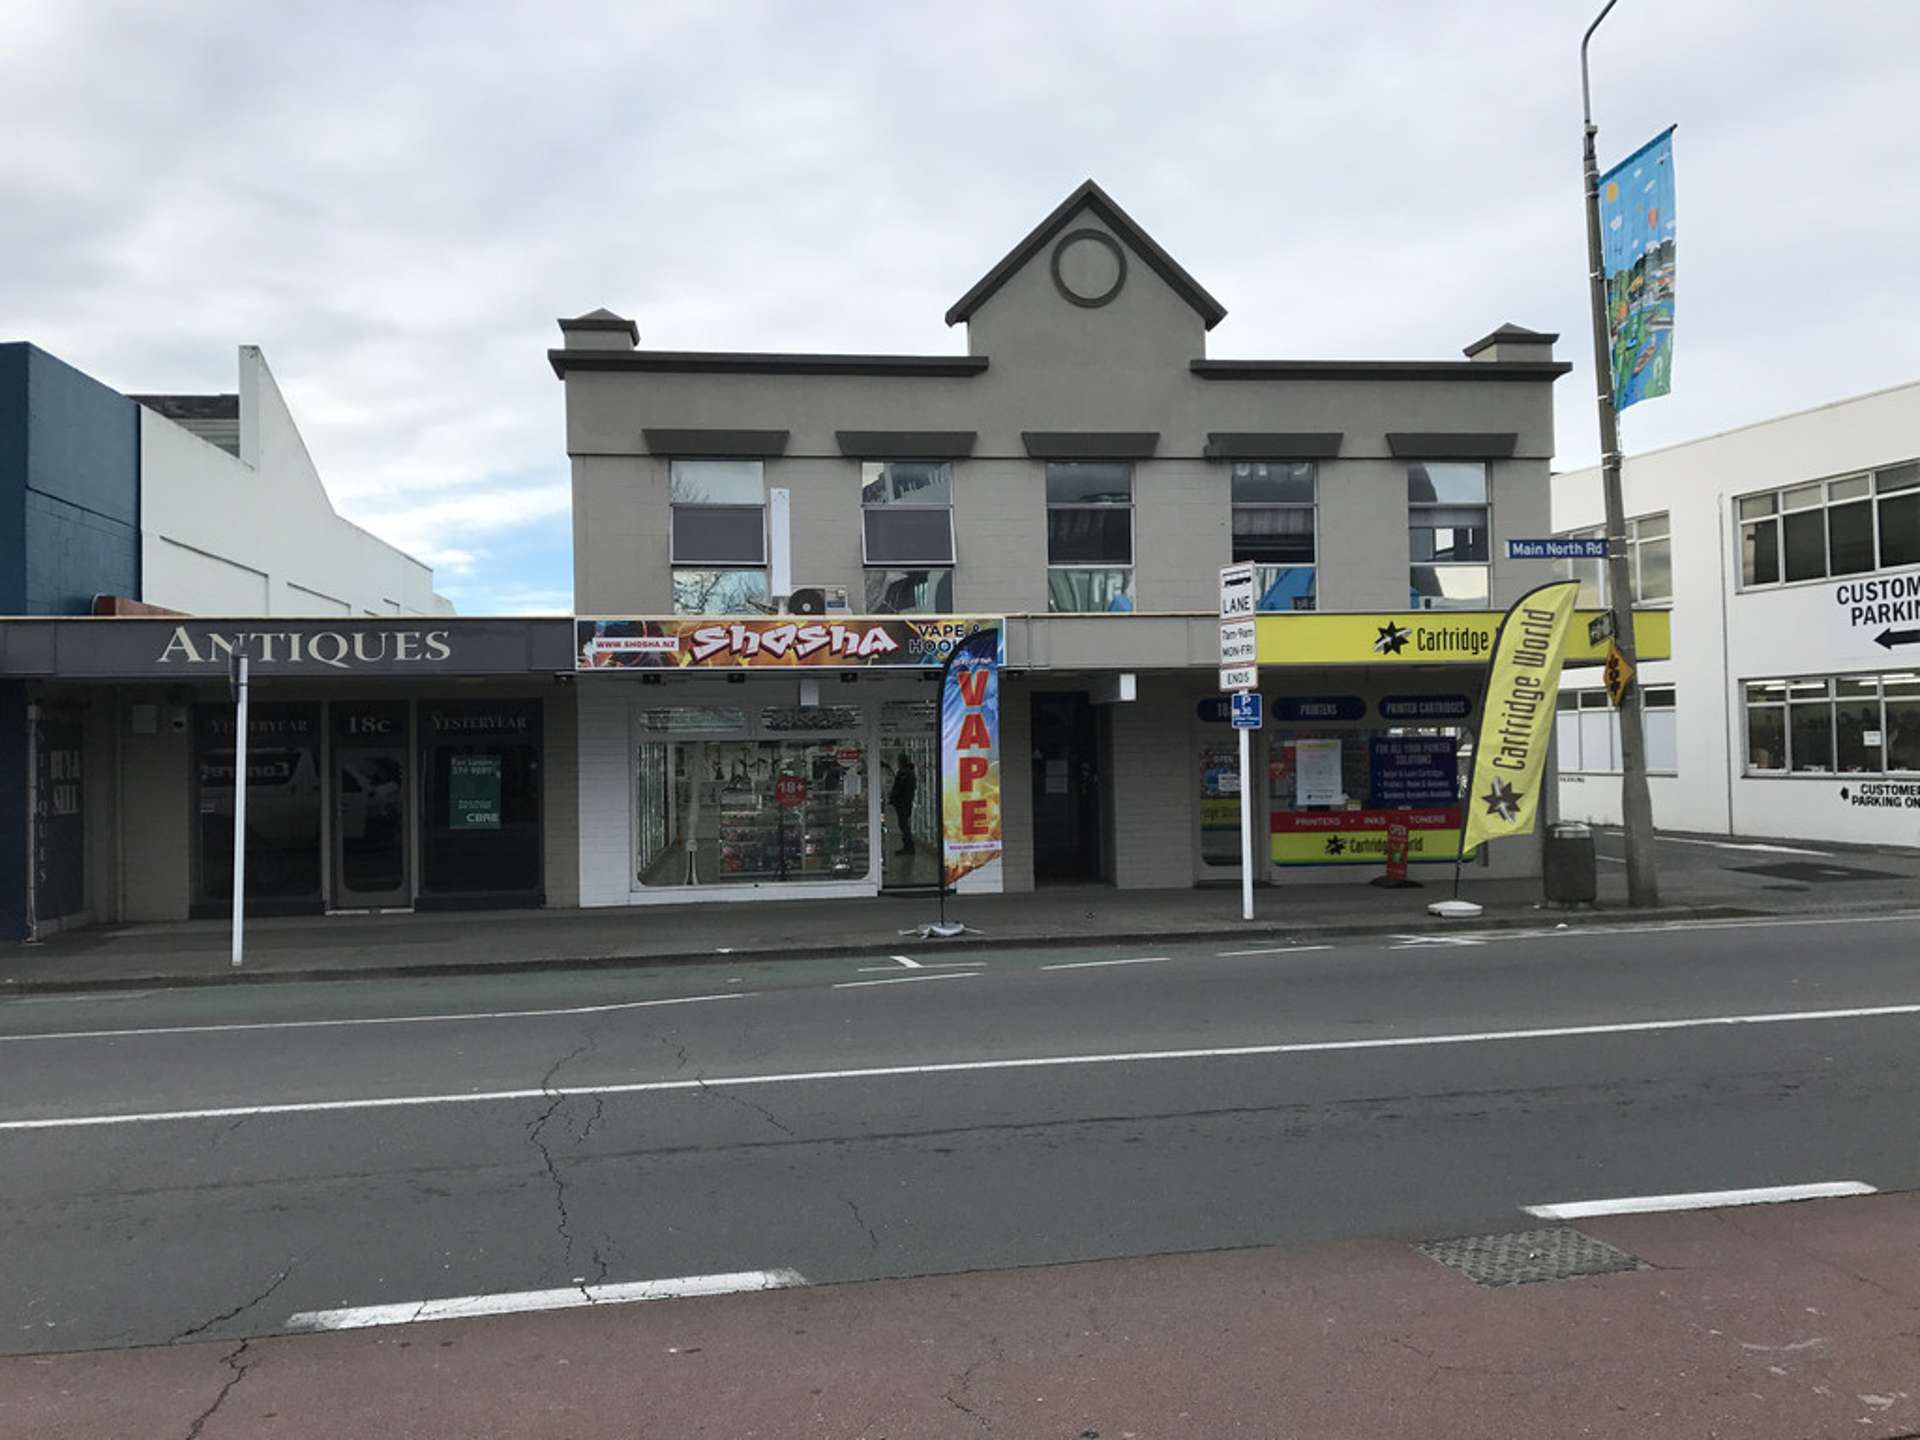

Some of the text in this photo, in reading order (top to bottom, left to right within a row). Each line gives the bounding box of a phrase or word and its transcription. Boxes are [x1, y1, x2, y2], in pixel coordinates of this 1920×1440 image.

[1512, 541, 1603, 555] Main North Rd
[1223, 595, 1251, 614] LANE
[918, 624, 964, 638] VAPE
[156, 625, 451, 668] ANTIQUES
[1416, 627, 1489, 655] Cartridge
[1227, 672, 1250, 685] ENDS
[1493, 609, 1555, 770] Cartridge World
[957, 671, 991, 836] VAPE
[1861, 783, 1920, 796] CUSTOME
[1852, 795, 1902, 807] PARKING
[1295, 817, 1341, 826] PRINTERS
[1363, 816, 1387, 825] INKS
